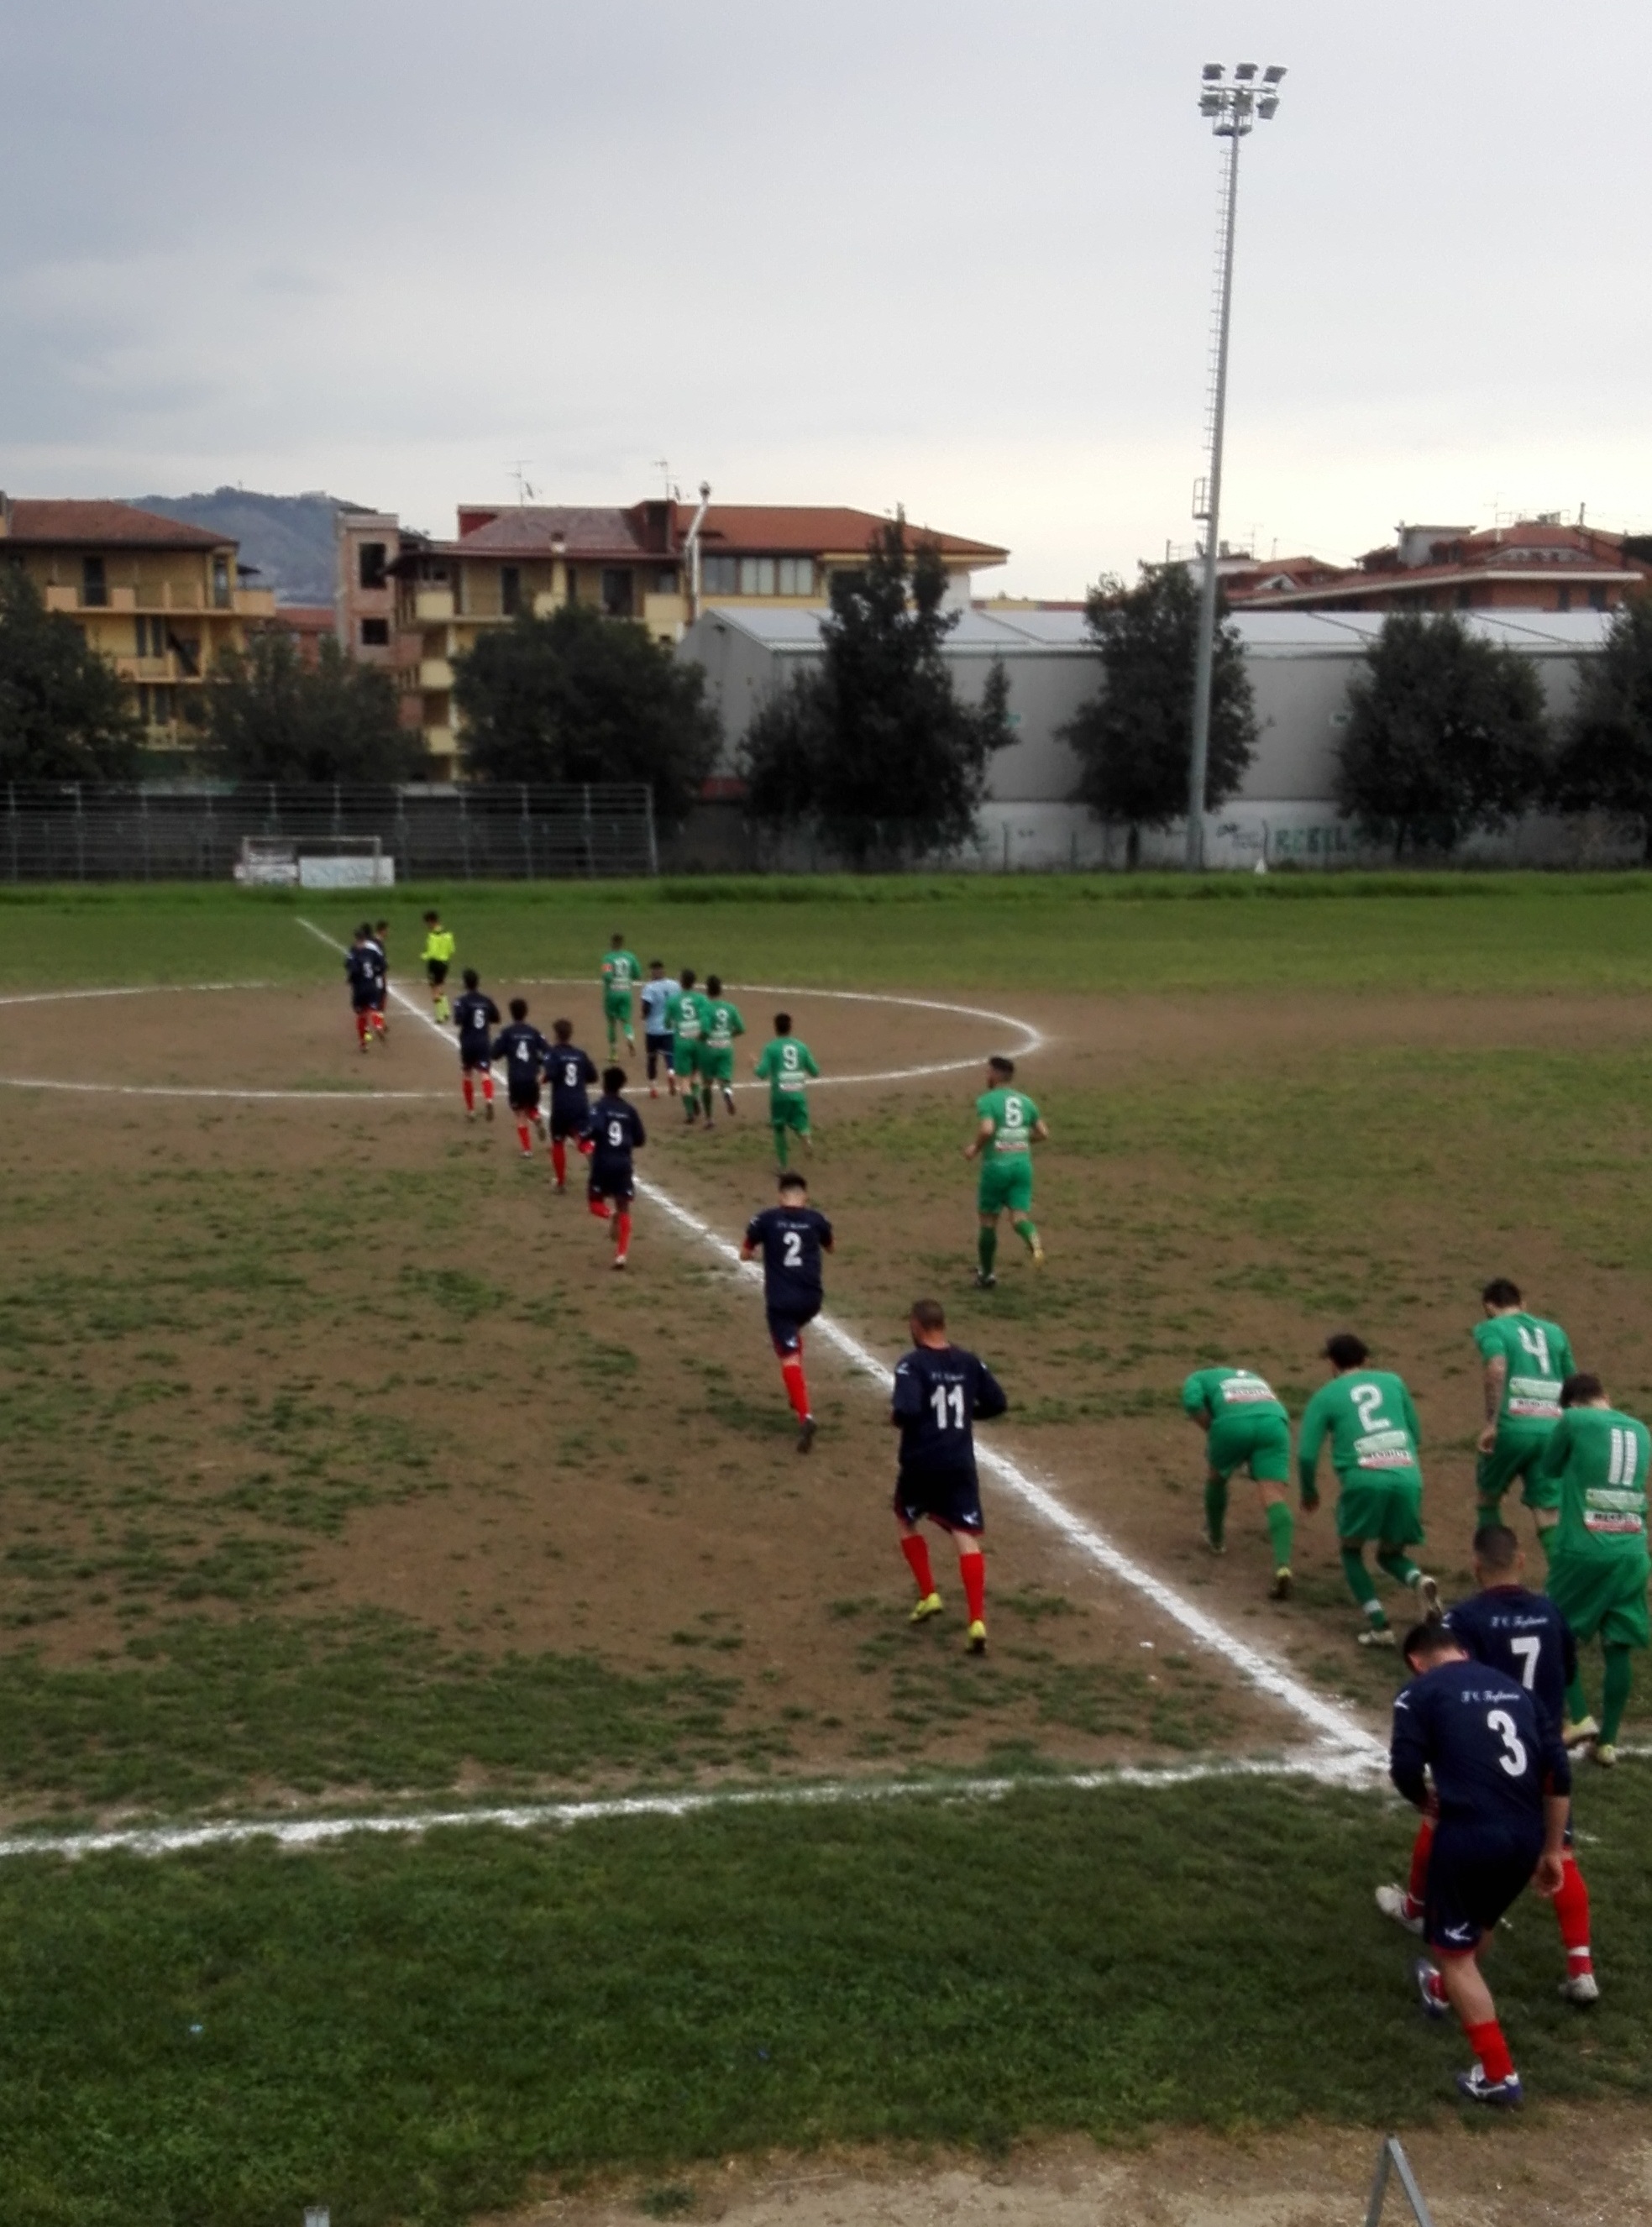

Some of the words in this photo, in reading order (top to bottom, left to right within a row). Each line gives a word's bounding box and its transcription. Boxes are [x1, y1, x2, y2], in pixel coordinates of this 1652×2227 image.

[679, 997, 696, 1023] 5
[516, 1040, 530, 1062] 4
[782, 1043, 799, 1072] 9
[1004, 1094, 1024, 1129] 6
[608, 1120, 623, 1147] 9
[783, 1230, 803, 1267] 2
[1518, 1325, 1551, 1375] 4
[930, 1384, 965, 1430] 11
[1349, 1382, 1392, 1433] 2
[1607, 1427, 1639, 1486] 11
[1510, 1635, 1542, 1690] 7
[1486, 1708, 1528, 1777] 3
